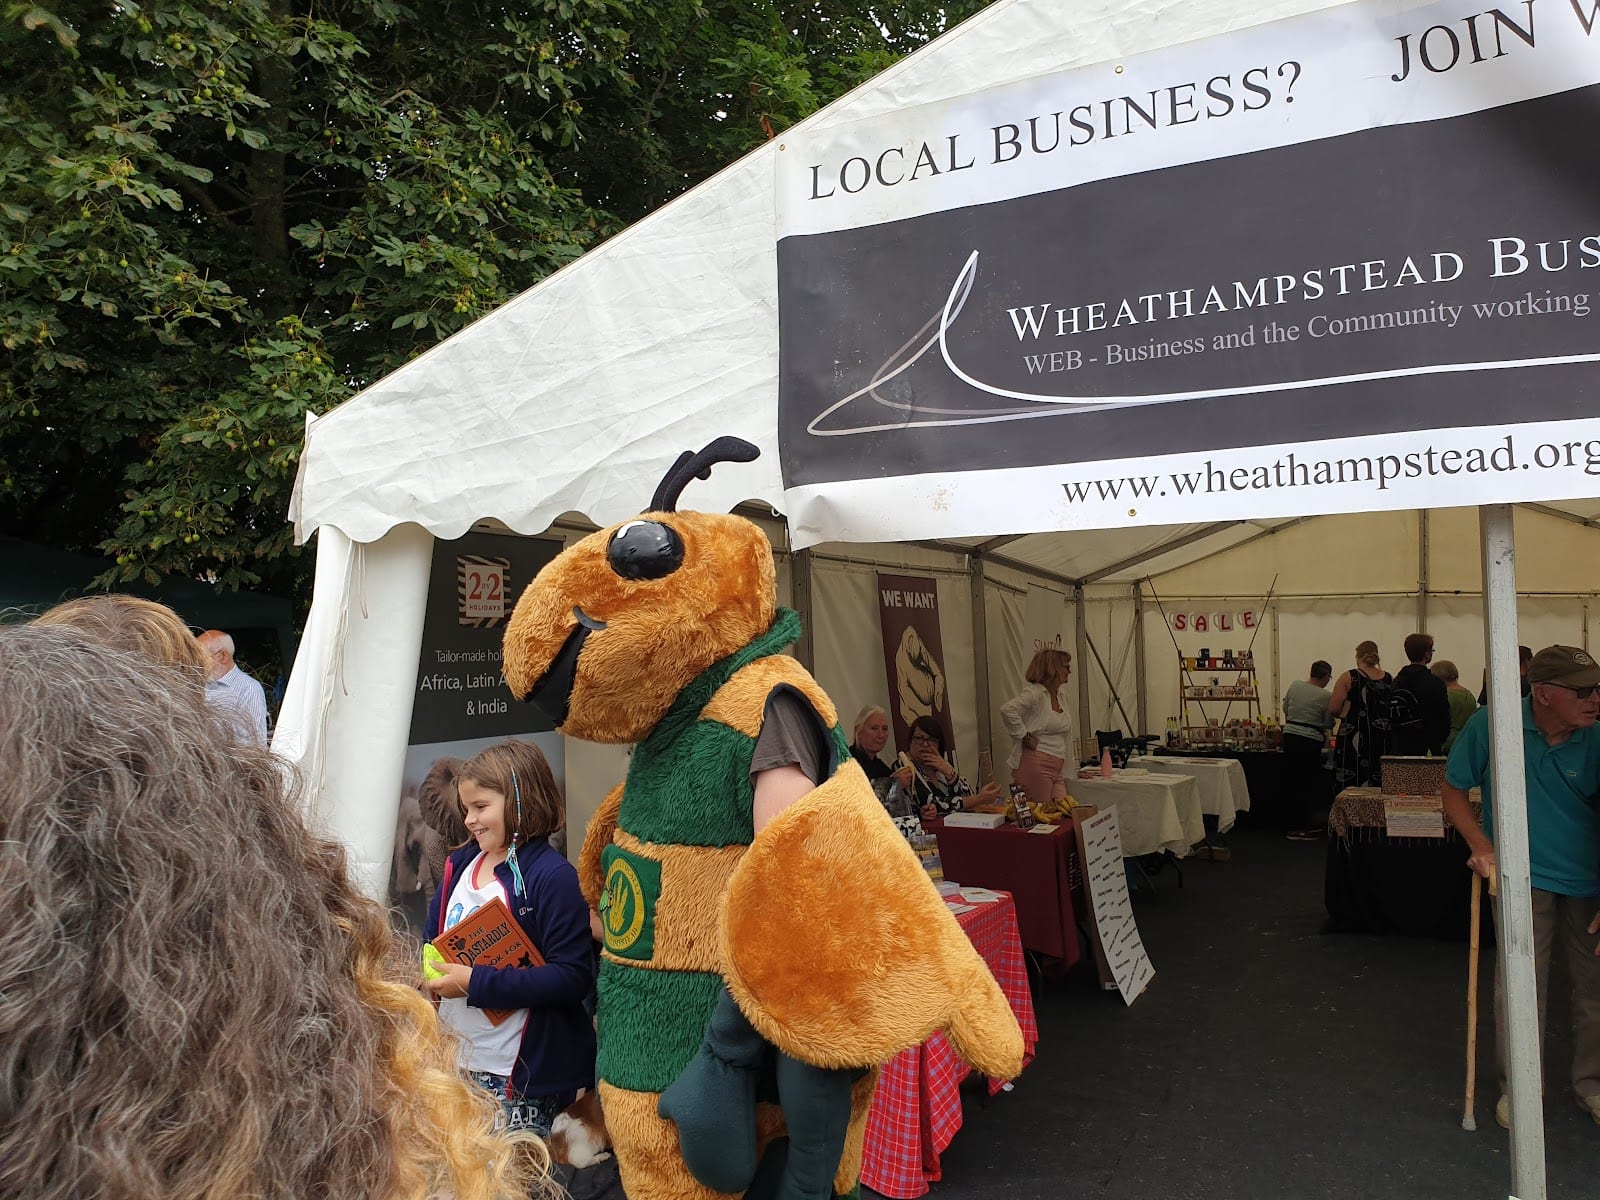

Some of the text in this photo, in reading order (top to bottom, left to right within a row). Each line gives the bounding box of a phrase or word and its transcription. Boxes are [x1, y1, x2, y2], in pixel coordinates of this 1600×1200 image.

[808, 134, 976, 200] LOCAL
[990, 61, 1301, 165] BUSINESS?
[1391, 0, 1536, 82] JOIN
[1006, 252, 1464, 342] WHEATHAMPSTEAD
[1023, 349, 1083, 375] WEB
[1104, 337, 1205, 366] Business
[1212, 326, 1256, 350] and
[1262, 321, 1300, 345] the
[1307, 300, 1463, 338] Community
[1472, 290, 1591, 318] working
[882, 590, 935, 609] WE WANT
[1174, 611, 1256, 631] SALE
[435, 650, 485, 663] Tailor-made
[420, 673, 463, 691] Africa,
[466, 672, 495, 689] Latin
[466, 699, 508, 715] & India
[456, 921, 511, 966] DASTARDLY
[468, 926, 486, 942] THE
[505, 941, 522, 955] FOR
